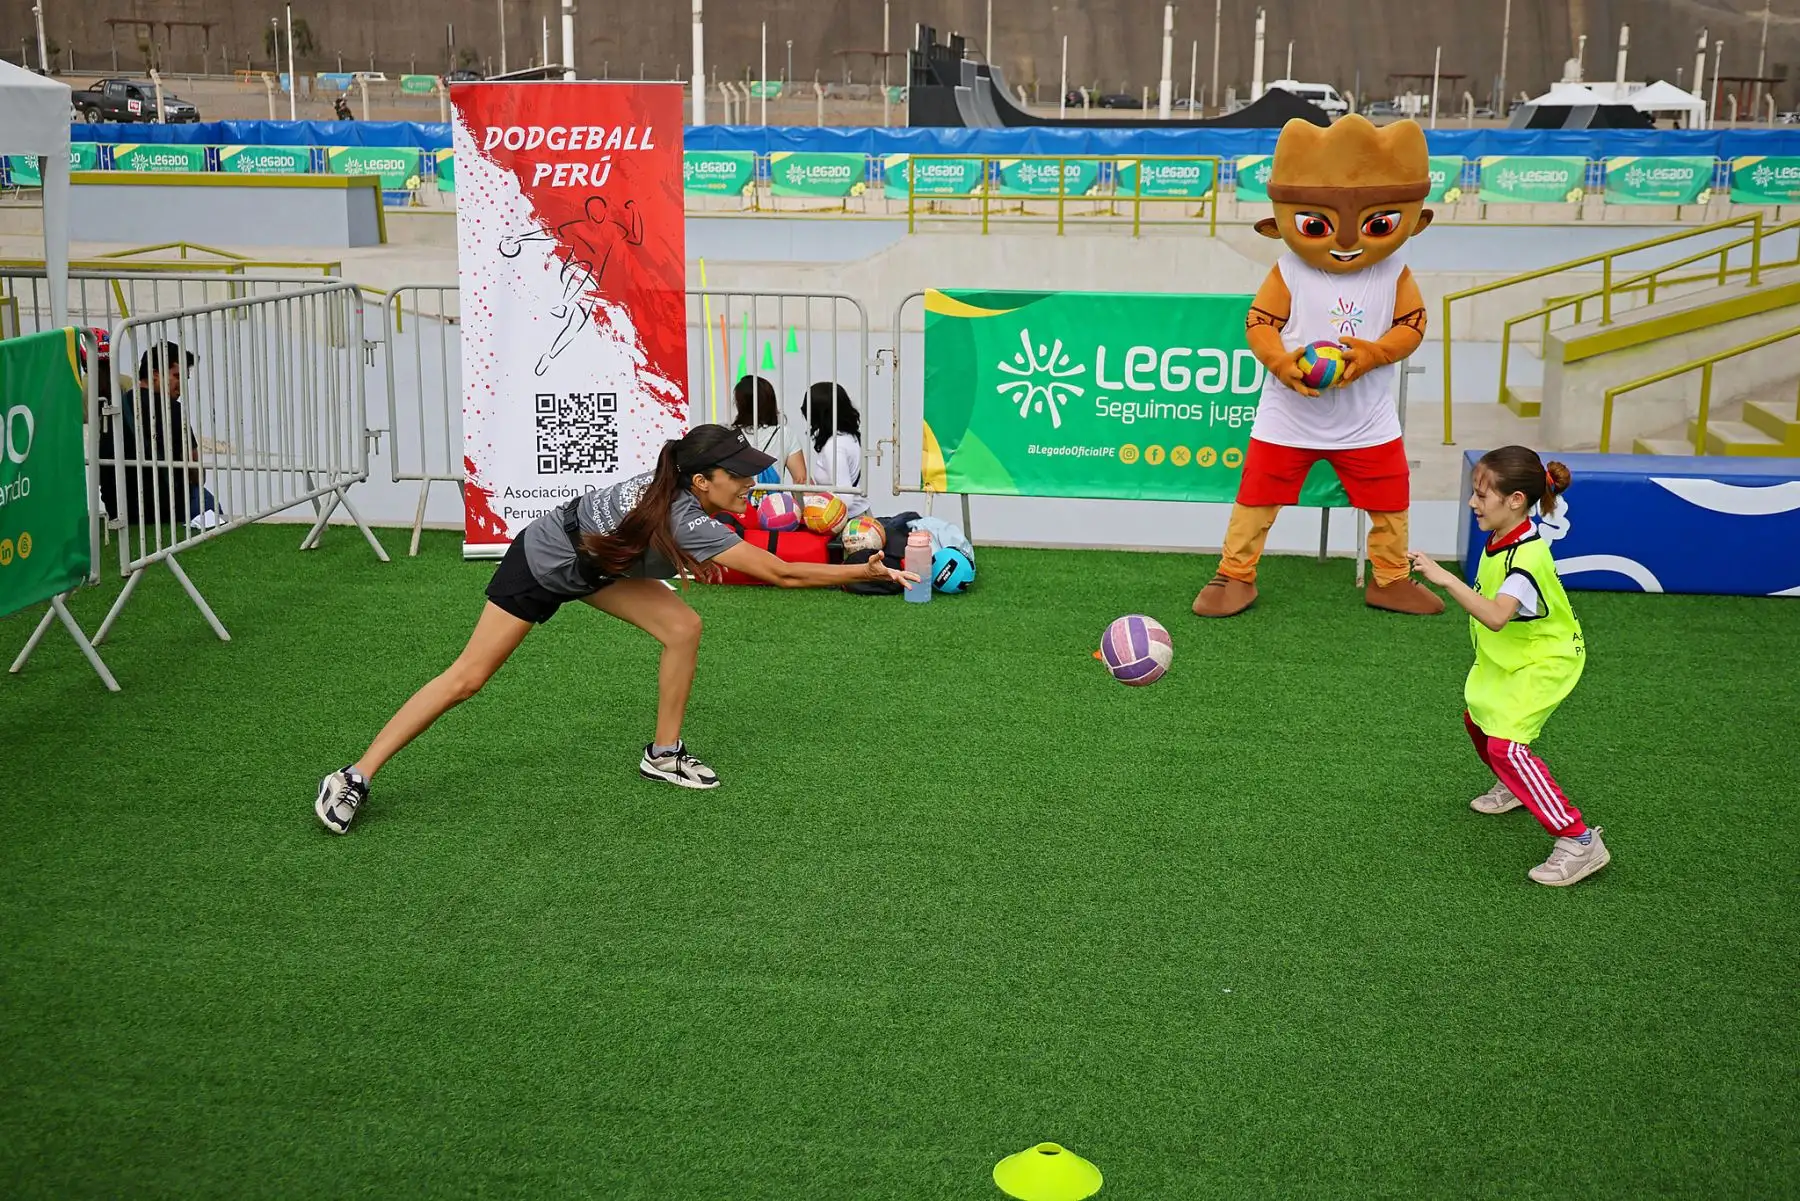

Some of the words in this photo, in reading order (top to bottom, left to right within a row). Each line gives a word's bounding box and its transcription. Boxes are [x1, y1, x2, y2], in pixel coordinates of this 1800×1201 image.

[483, 126, 655, 151] DODGEBALL
[532, 155, 612, 188] PERÚ
[1037, 165, 1081, 176] LEGDO
[1095, 396, 1203, 425] Seguimos
[1027, 444, 1116, 458] @LegadoOficialPE
[503, 485, 579, 499] Asociación
